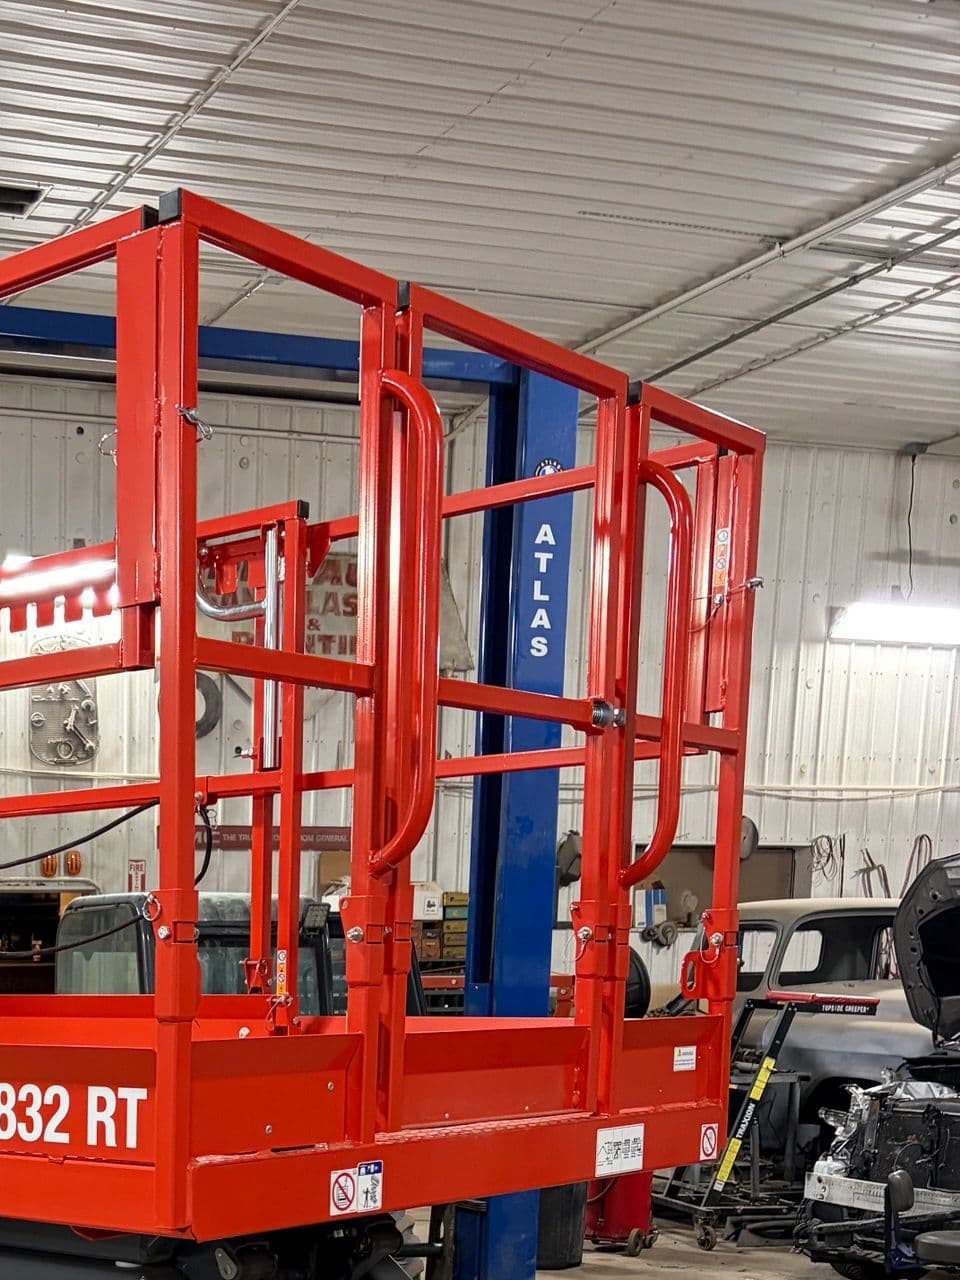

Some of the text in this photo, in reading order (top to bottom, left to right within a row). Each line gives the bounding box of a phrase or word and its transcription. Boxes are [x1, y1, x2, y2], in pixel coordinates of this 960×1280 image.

[530, 524, 556, 657] ATLAS
[307, 618, 320, 631] &
[87, 1086, 148, 1149] RT
[735, 1102, 756, 1138] TRAXION
